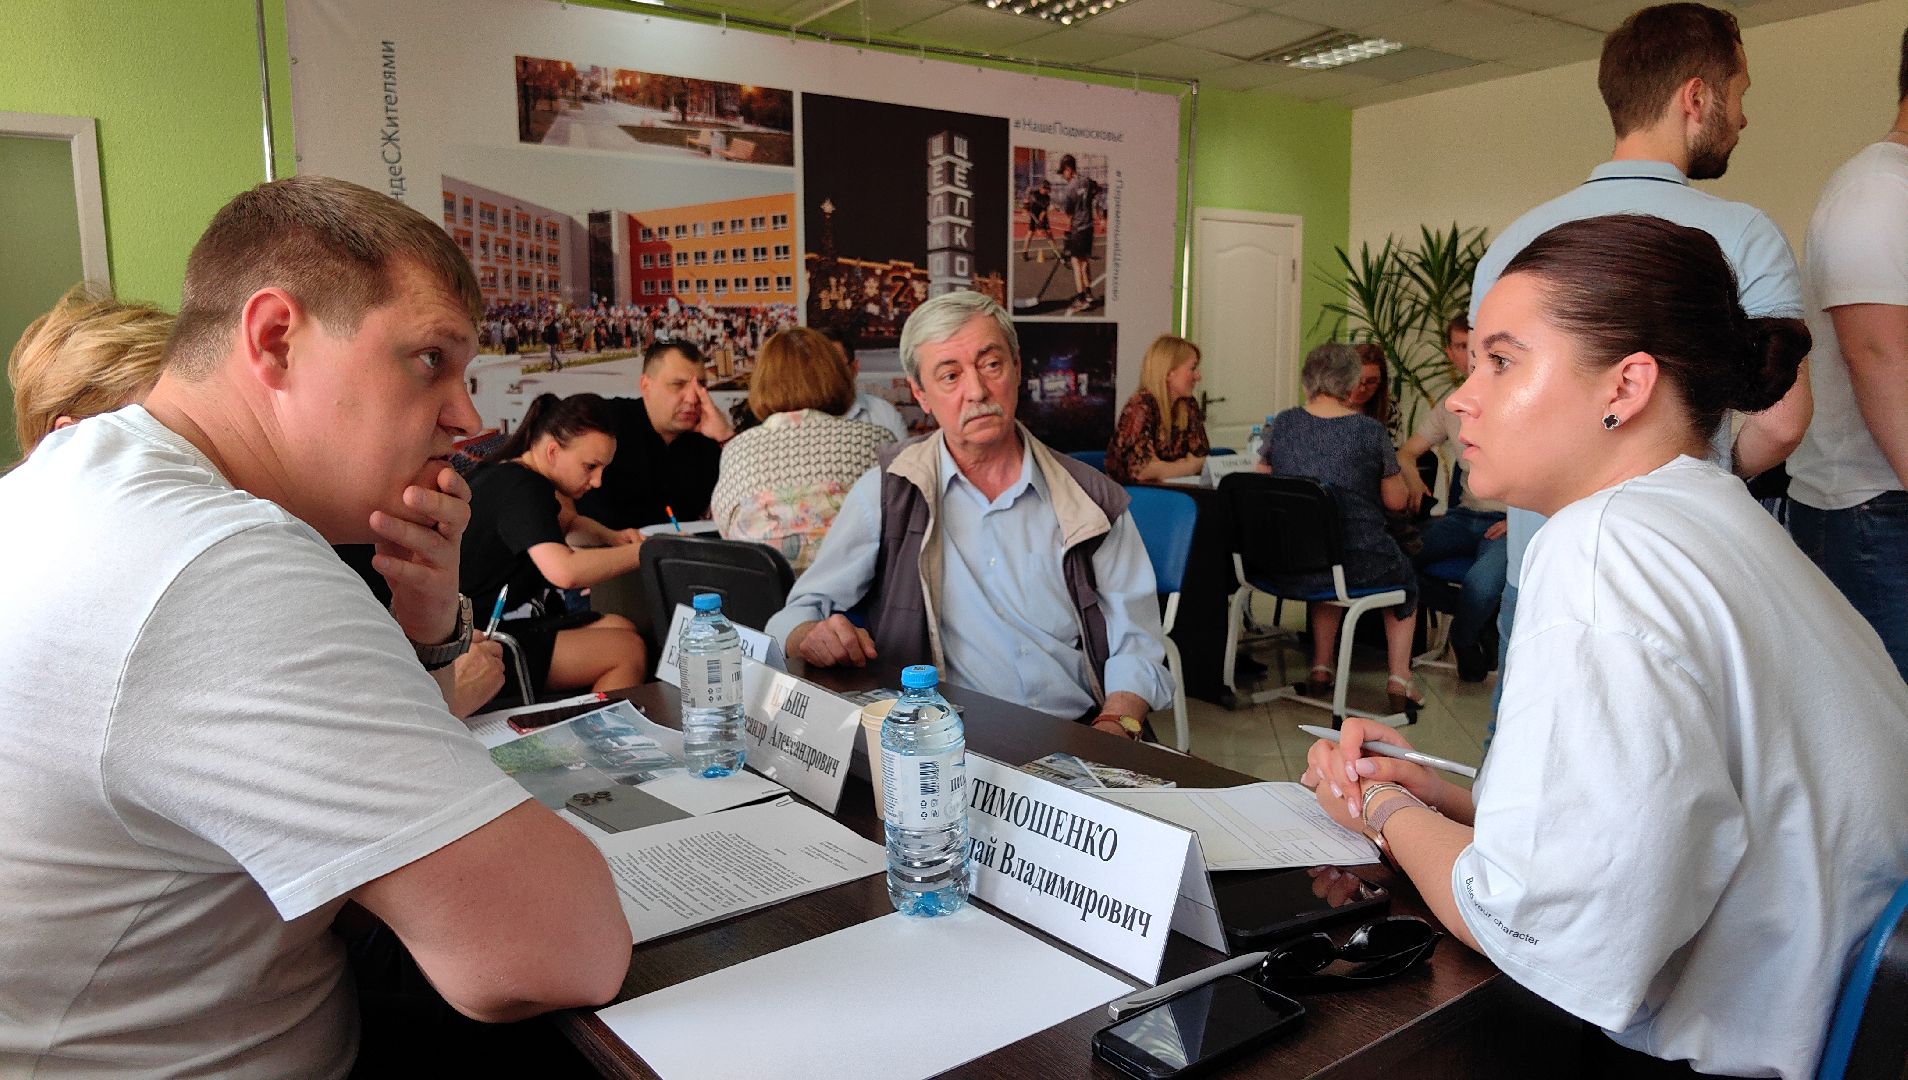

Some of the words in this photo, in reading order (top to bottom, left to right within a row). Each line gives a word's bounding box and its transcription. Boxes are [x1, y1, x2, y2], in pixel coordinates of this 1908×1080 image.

[381, 39, 407, 200] ндеСЖителями
[744, 714, 768, 747] сандр
[969, 777, 1118, 862] ТИМОШЕНКО
[997, 841, 1153, 938] Владимирович
[1474, 900, 1492, 918] your
[1493, 918, 1540, 946] character
